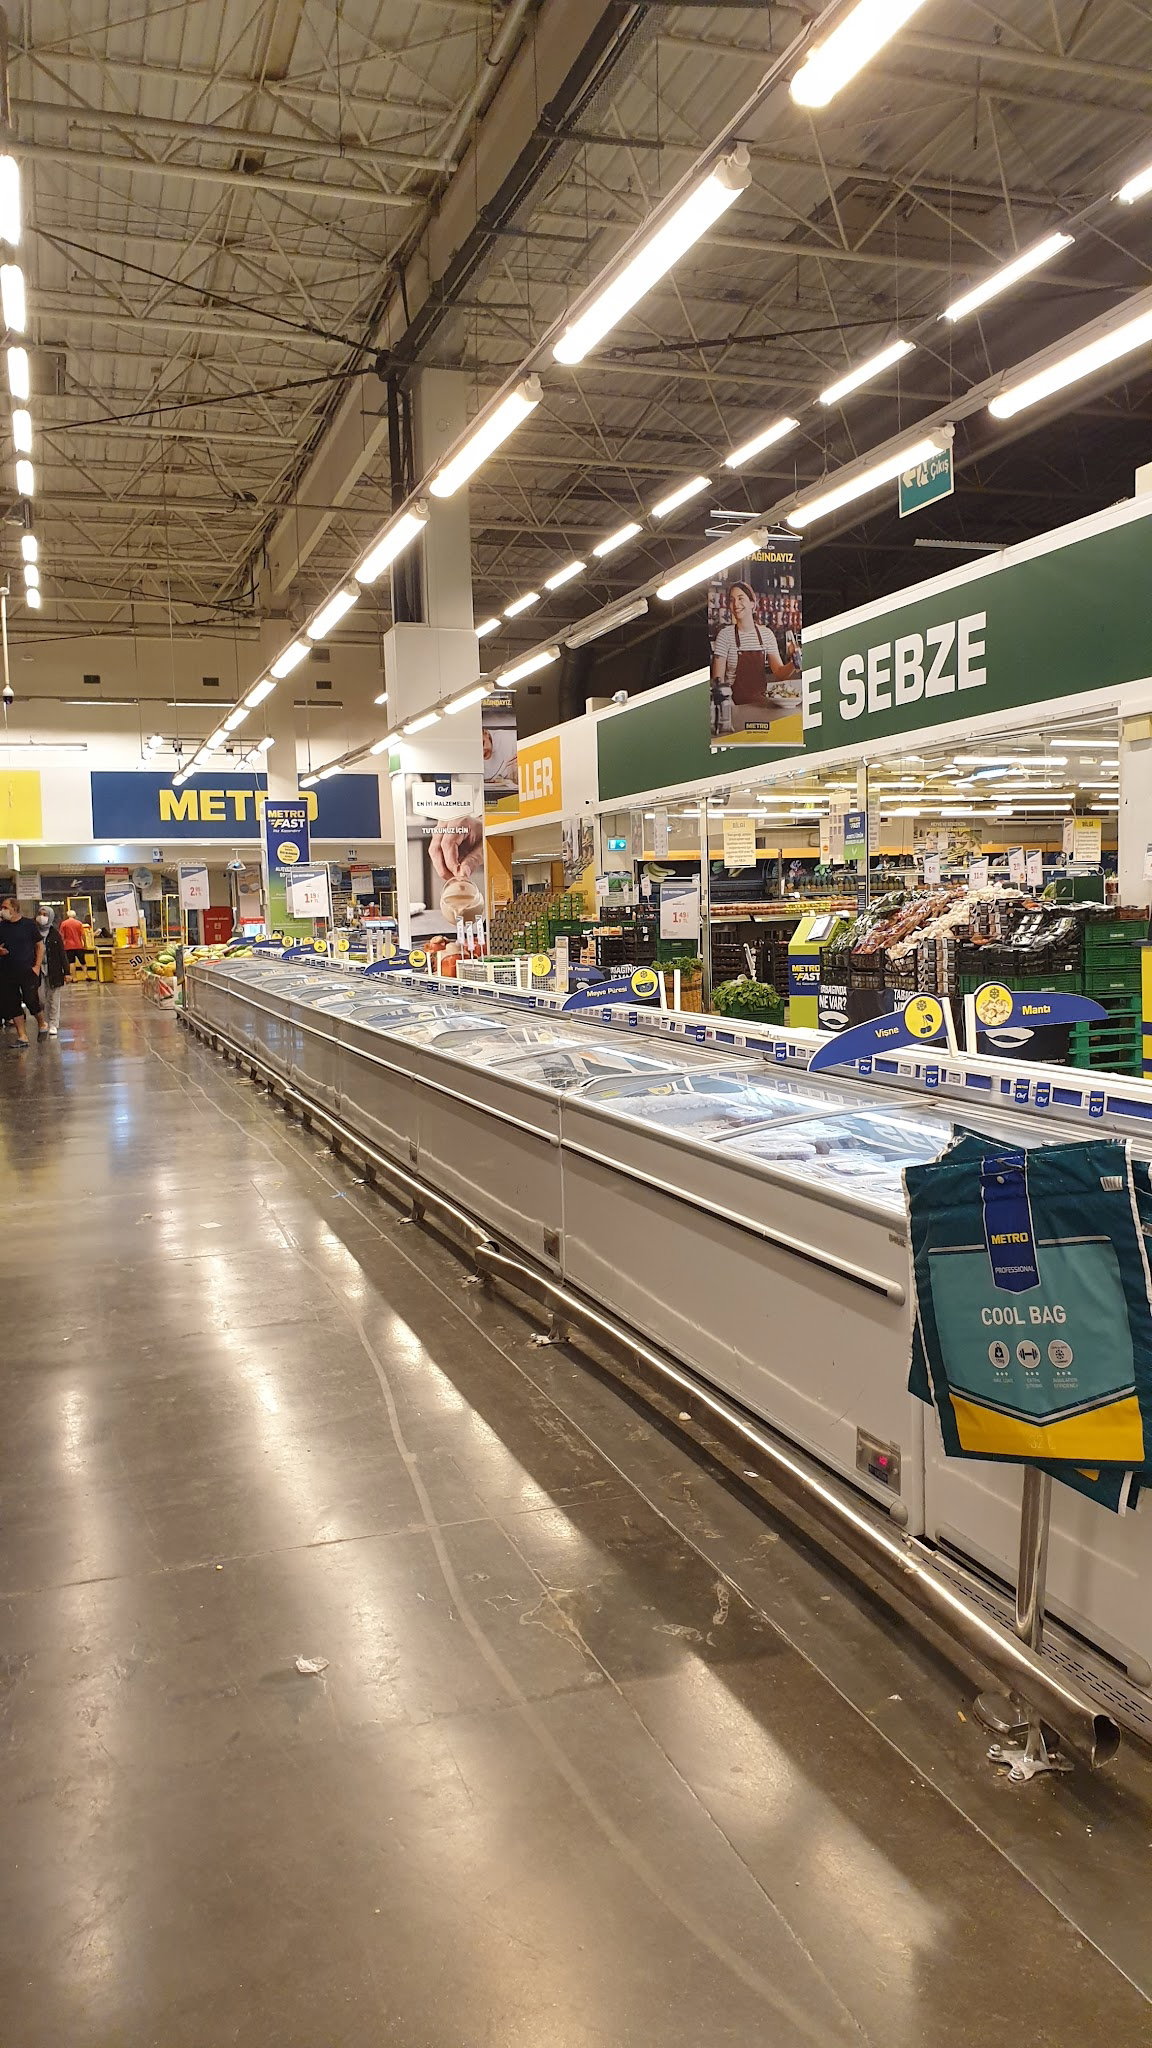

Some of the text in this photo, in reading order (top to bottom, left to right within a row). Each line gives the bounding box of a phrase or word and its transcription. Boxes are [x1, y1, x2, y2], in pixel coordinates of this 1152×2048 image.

[930, 459, 949, 480] Çıkış
[839, 611, 987, 721] SEBZE
[267, 809, 305, 818] METRO
[269, 818, 306, 828] FAST
[456, 826, 469, 835] İÇİN
[129, 954, 143, 968] 50
[791, 964, 820, 972] METRO
[793, 972, 820, 981] FAST
[586, 985, 628, 998] Meyve Püresi
[819, 995, 847, 1011] NE VAR?
[1022, 1004, 1051, 1016] Mantı
[875, 1026, 899, 1038] Vişne
[1090, 1105, 1102, 1113] Chef
[991, 1232, 1029, 1245] METRO
[994, 1265, 1036, 1274] PROFESSIONAL
[981, 1305, 1067, 1326] COOL BAG
